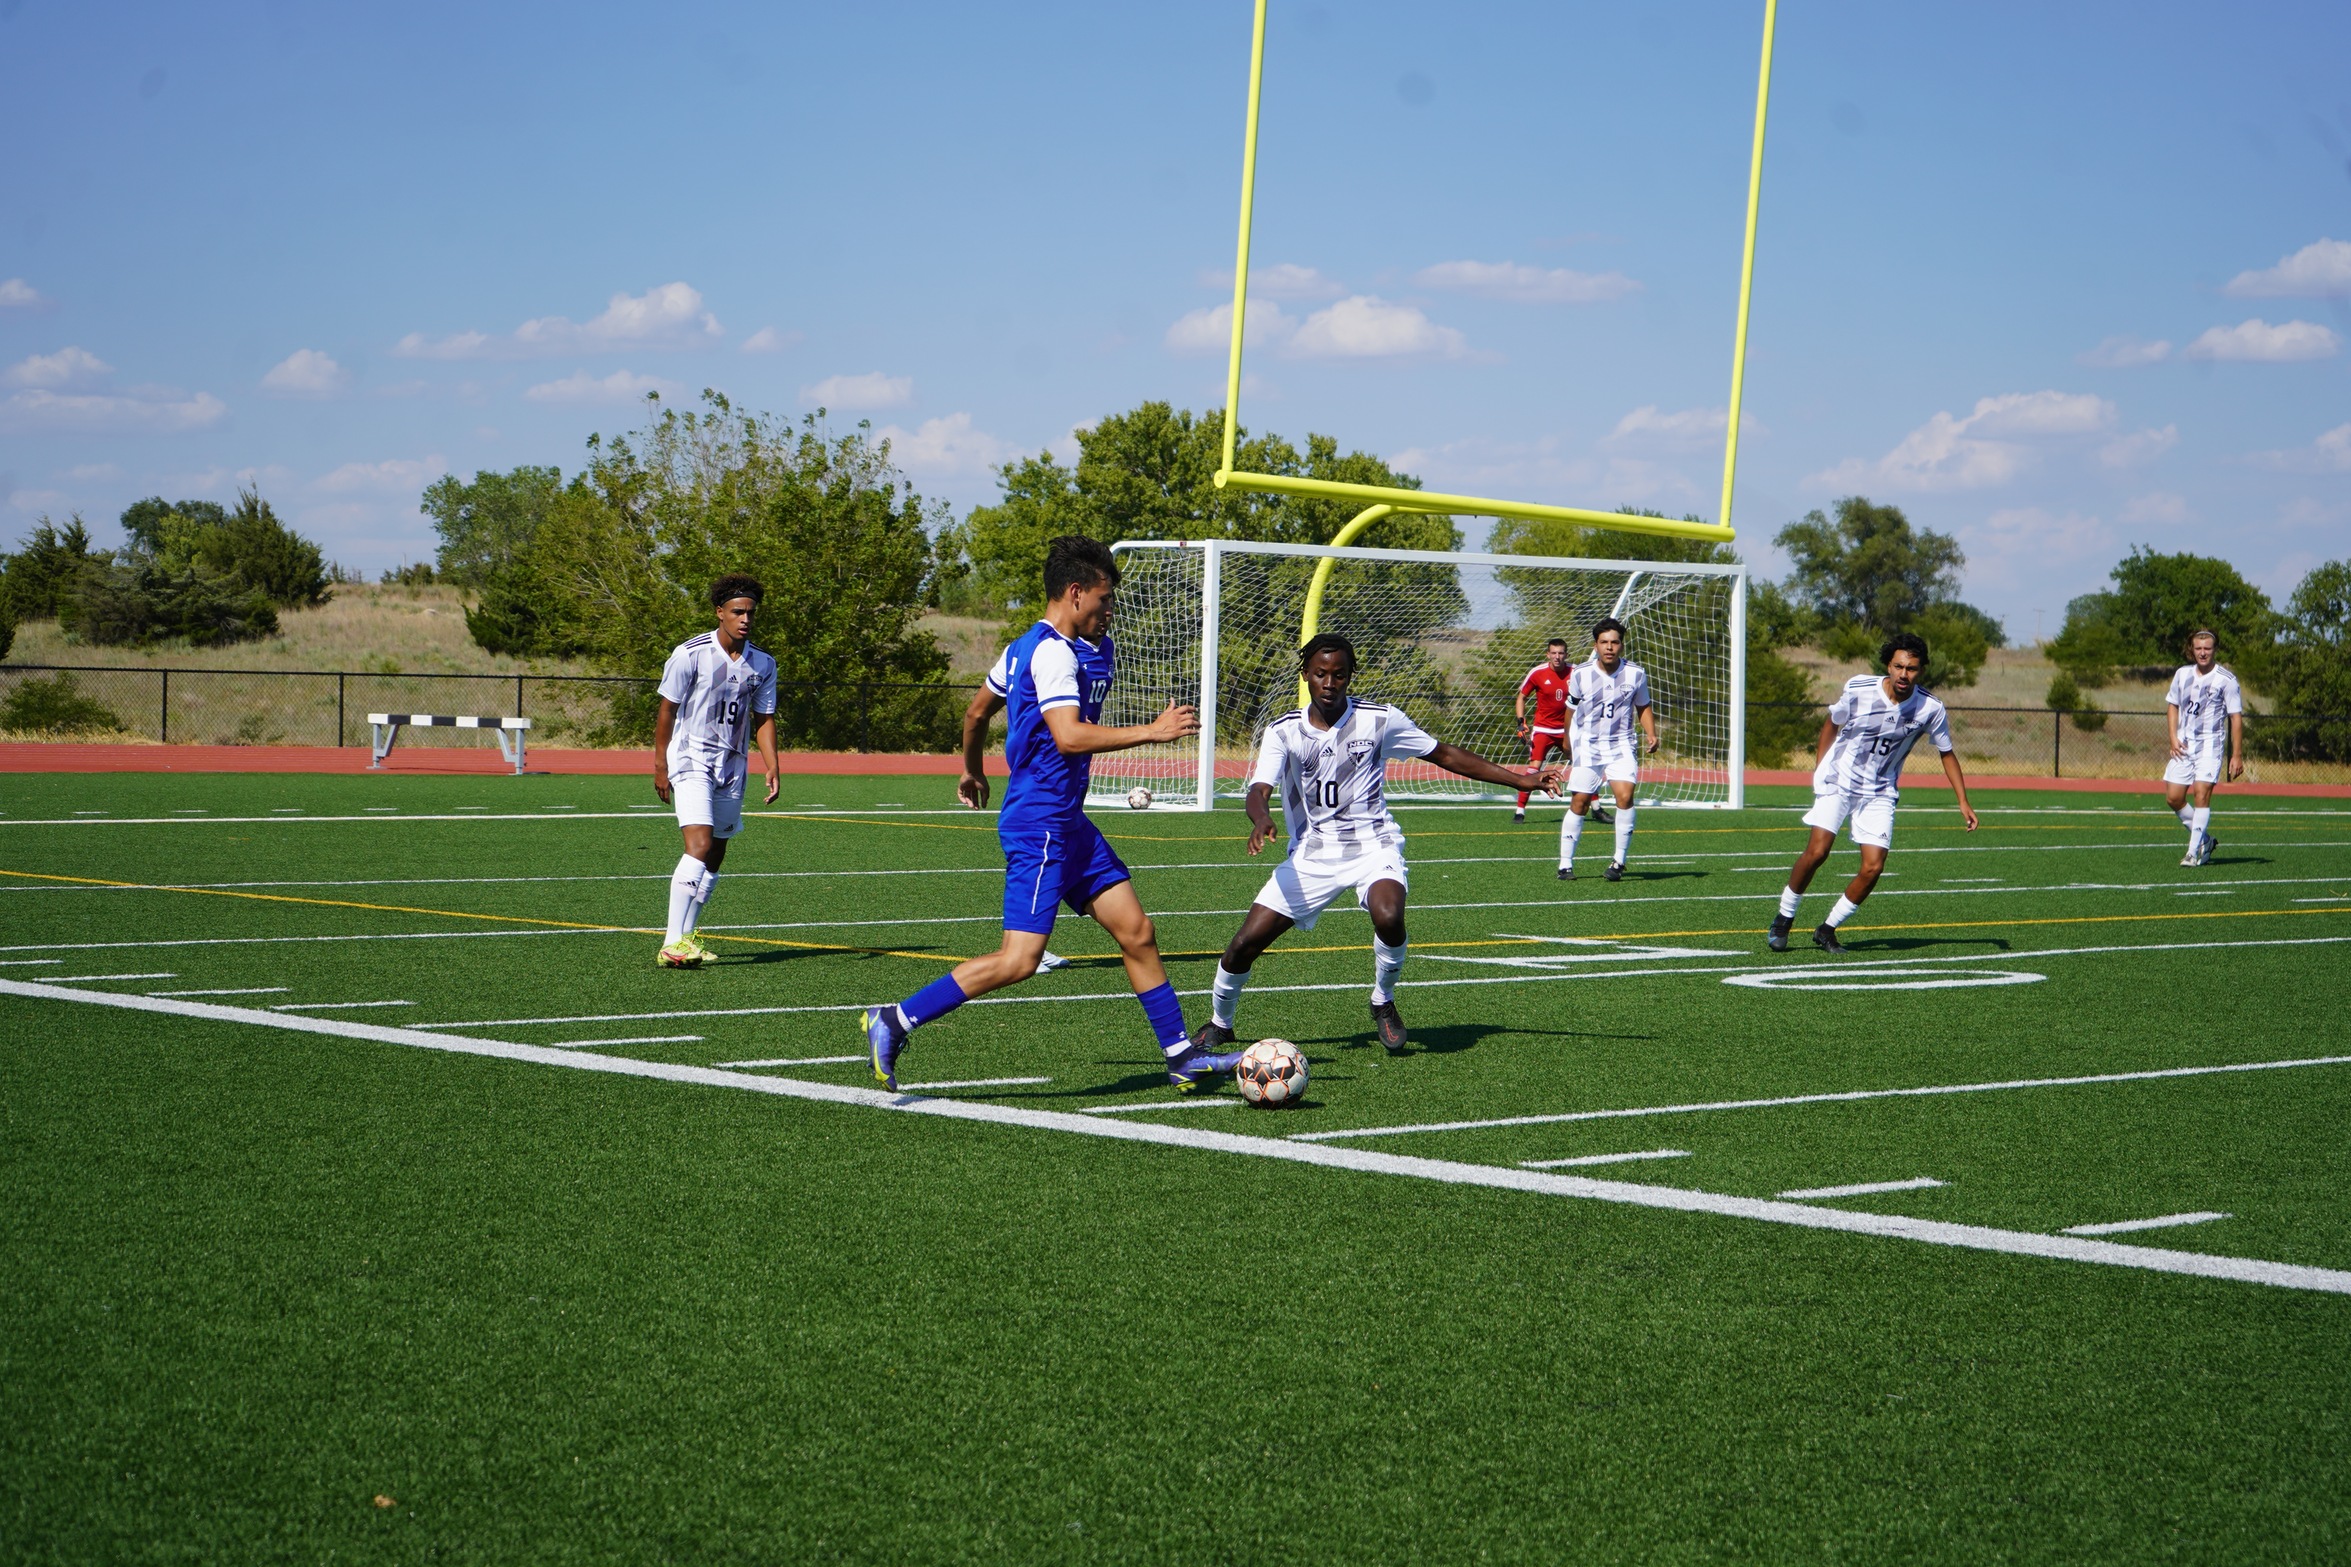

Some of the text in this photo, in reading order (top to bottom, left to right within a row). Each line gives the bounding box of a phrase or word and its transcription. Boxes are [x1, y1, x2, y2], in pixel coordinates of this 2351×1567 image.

[1089, 680, 1107, 703] 10
[1555, 688, 1563, 702] 0
[717, 701, 738, 725] 19
[1599, 703, 1614, 719] 13
[2187, 700, 2200, 716] 22
[1869, 736, 1892, 757] 15
[1315, 779, 1339, 809] 10
